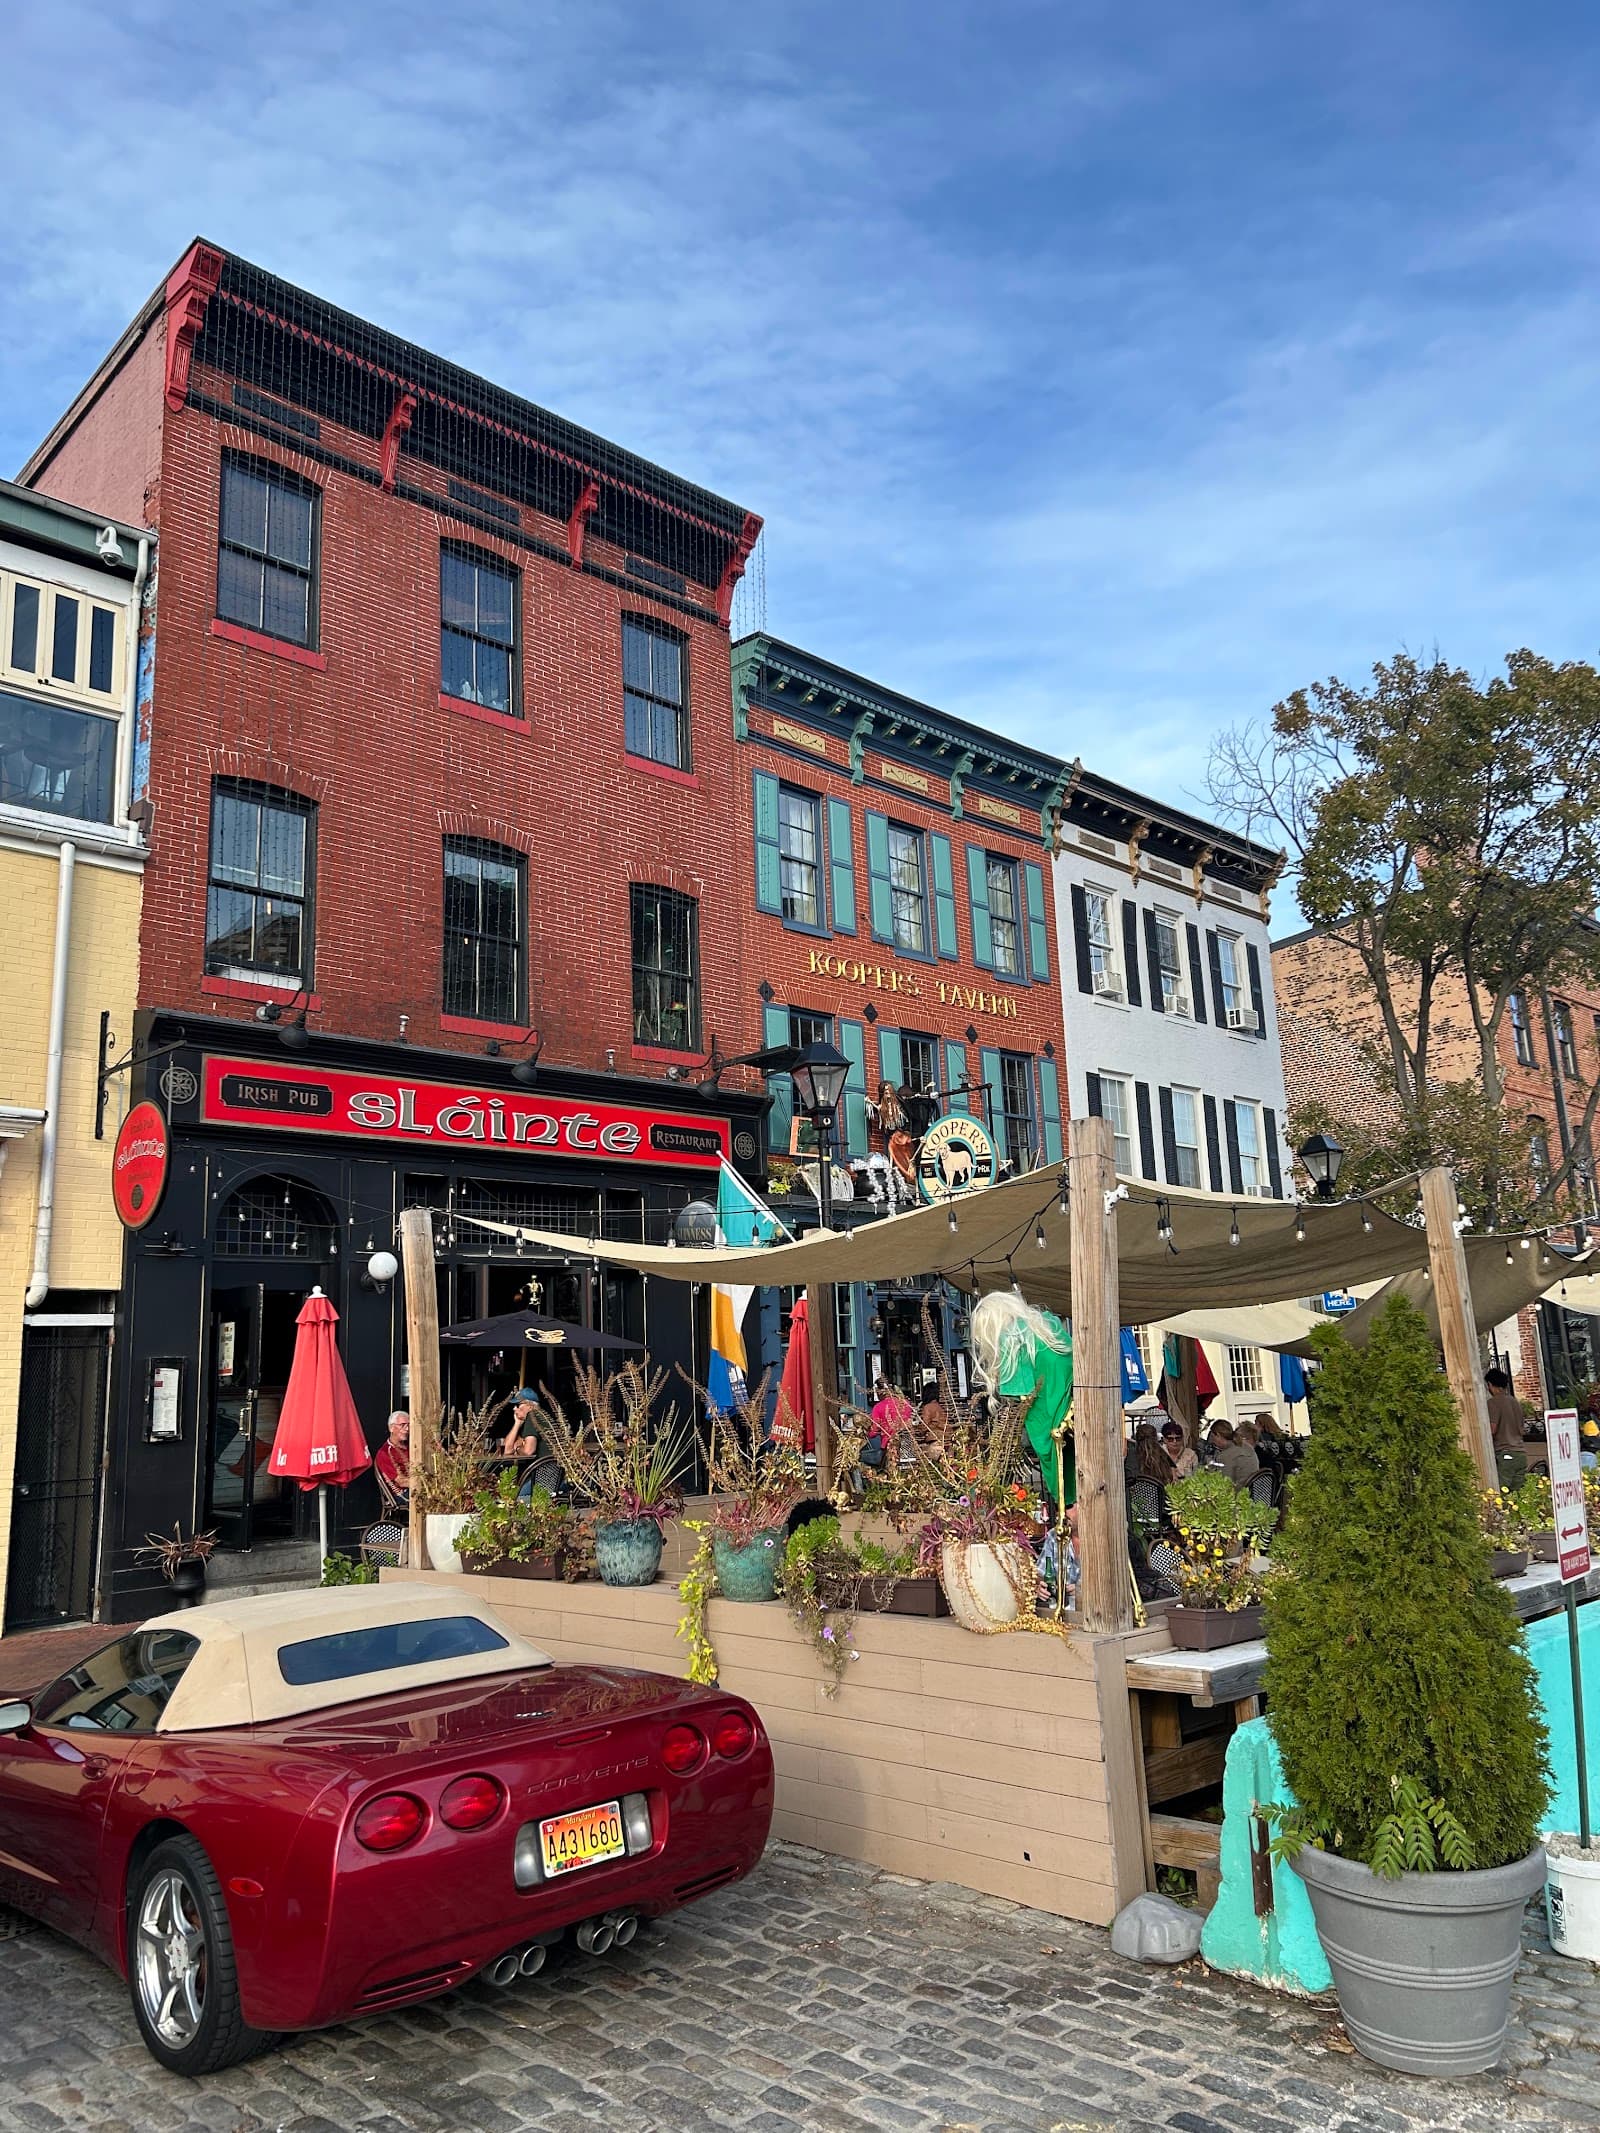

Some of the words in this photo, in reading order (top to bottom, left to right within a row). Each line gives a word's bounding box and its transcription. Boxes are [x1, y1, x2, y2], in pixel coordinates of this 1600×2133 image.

[808, 949, 922, 997] KOOPERS
[935, 980, 1017, 1018] TAVERN
[237, 1083, 279, 1105] IRISH
[289, 1089, 319, 1106] PUB
[656, 1130, 719, 1150] RESTAURANT
[924, 1121, 988, 1157] KOOPER'S
[1327, 1299, 1352, 1307] HERE
[1558, 1432, 1571, 1459] NO
[1555, 1480, 1583, 1509] STOPPING
[528, 1756, 649, 1793] CORVETTE
[565, 1810, 597, 1825] Maryland
[548, 1817, 619, 1862] A431680
